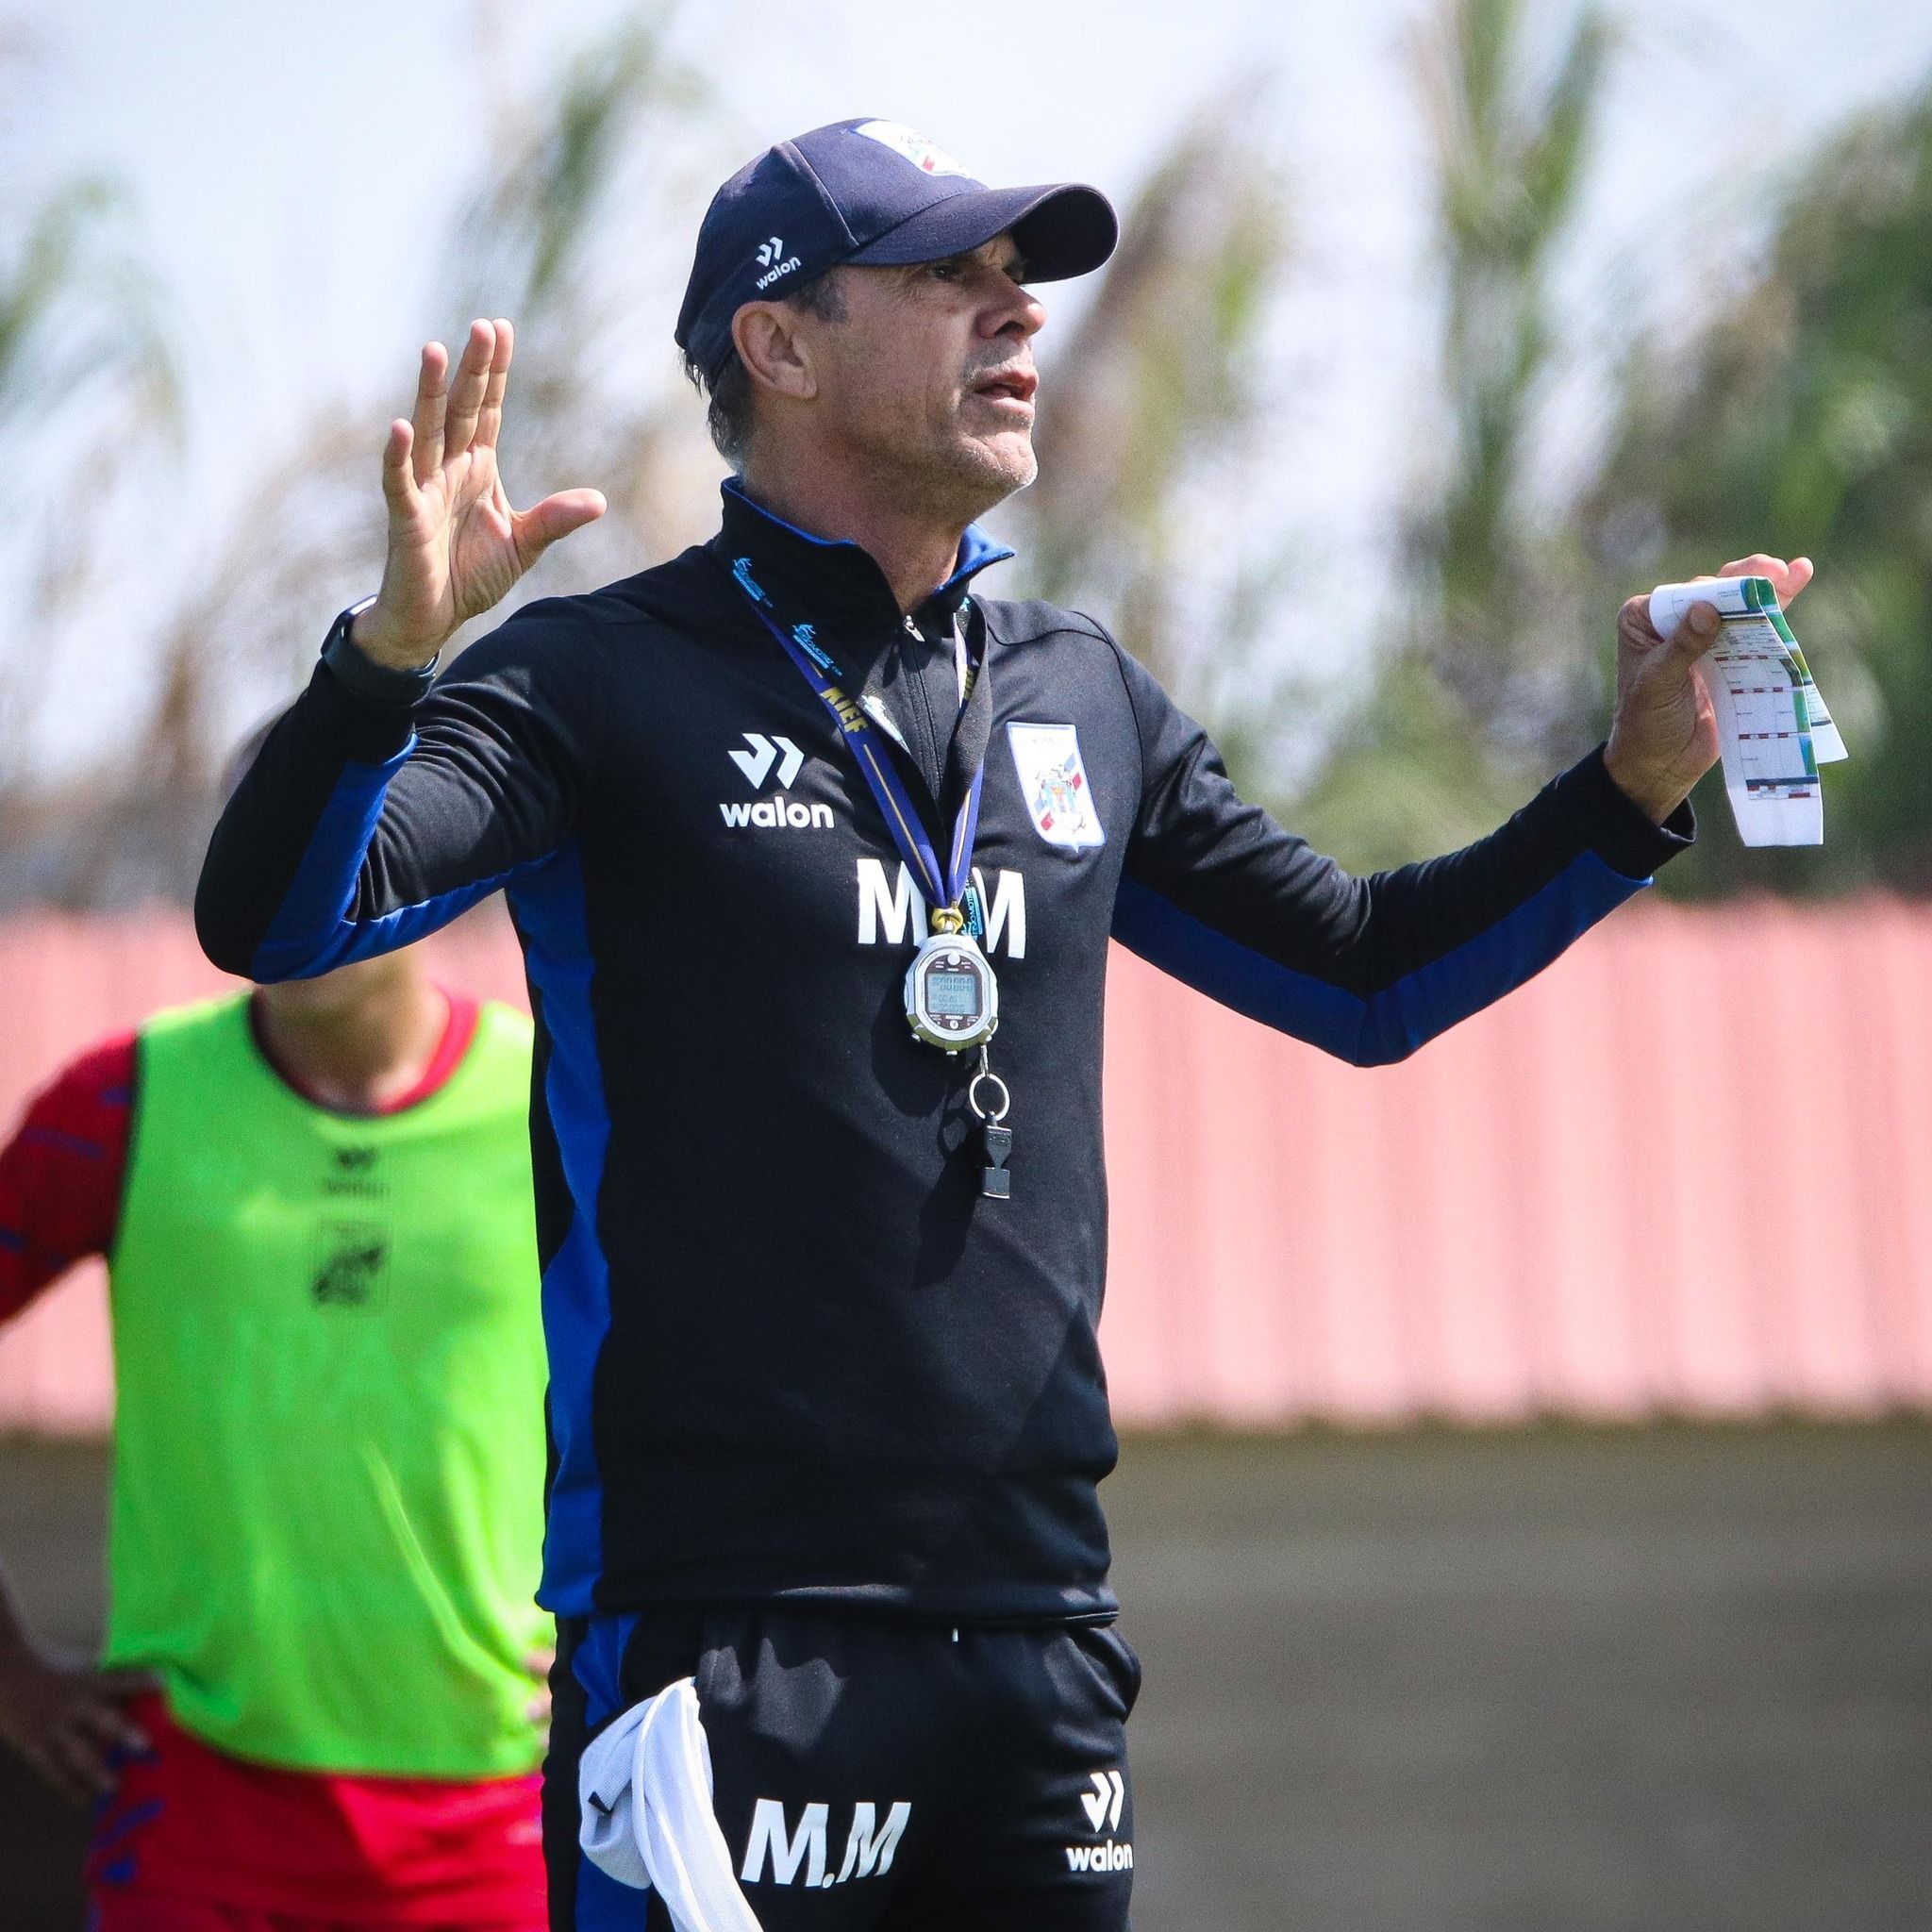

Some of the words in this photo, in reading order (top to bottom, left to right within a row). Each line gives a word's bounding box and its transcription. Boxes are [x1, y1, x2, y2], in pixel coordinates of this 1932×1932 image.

[756, 256, 802, 291] walon
[720, 796, 835, 829] walon
[741, 1797, 912, 1889] M.M
[1066, 1839, 1134, 1873] walon
